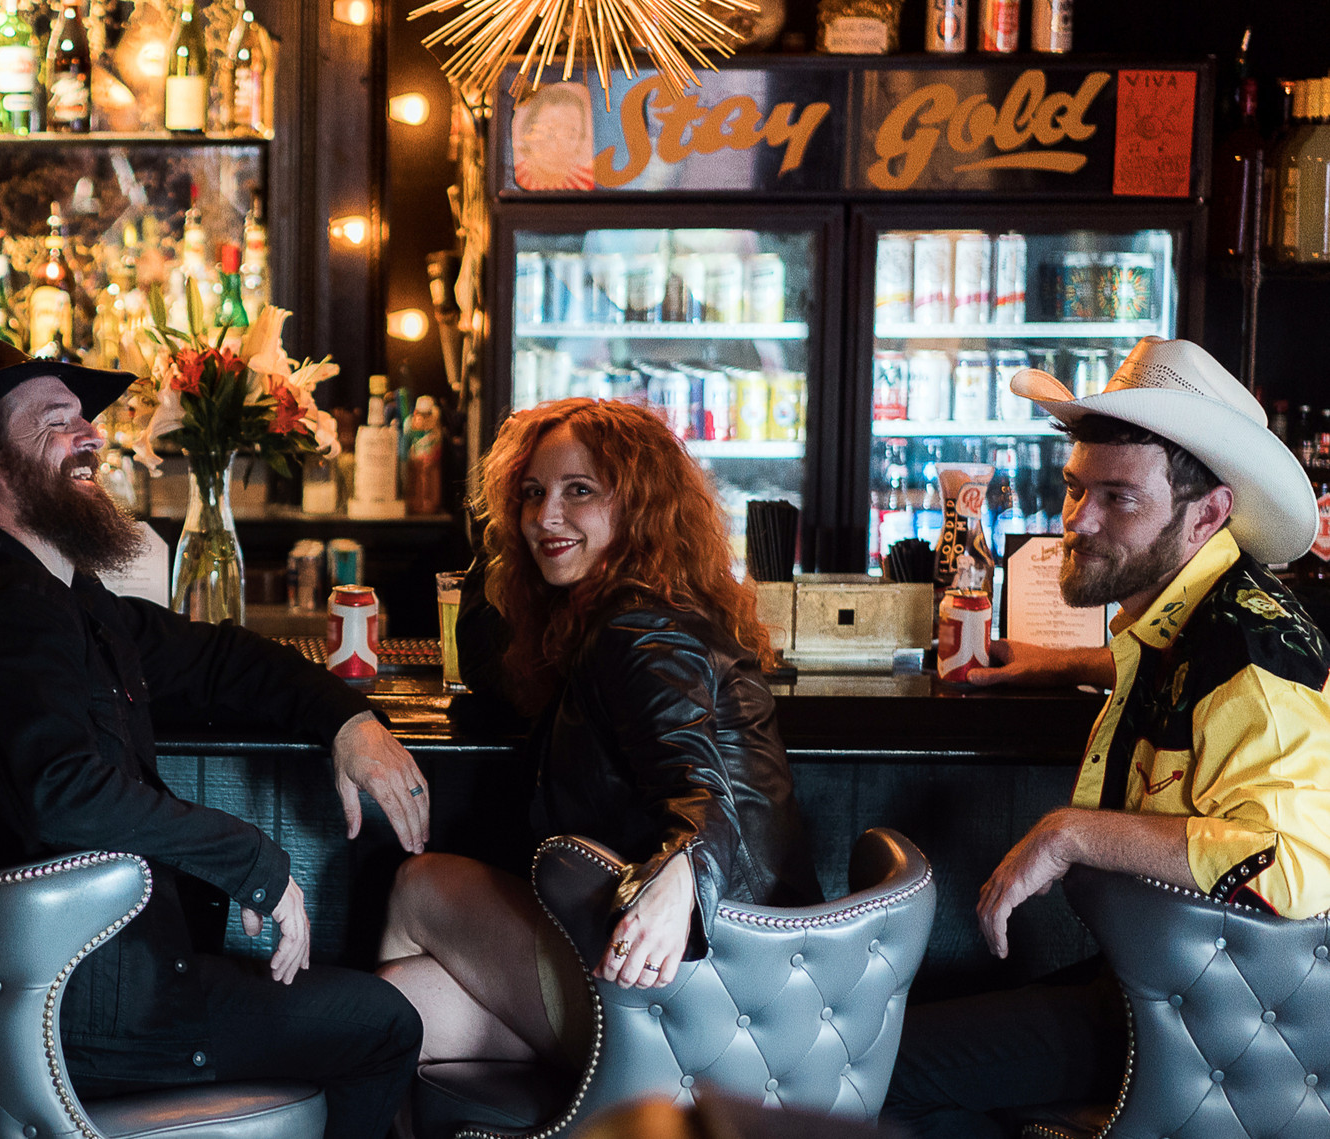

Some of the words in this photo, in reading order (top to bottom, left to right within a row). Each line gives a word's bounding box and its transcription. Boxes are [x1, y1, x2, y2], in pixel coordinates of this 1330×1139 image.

[1125, 74, 1178, 89] VIVA
[594, 75, 831, 187] Stay
[867, 69, 1111, 191] Gold
